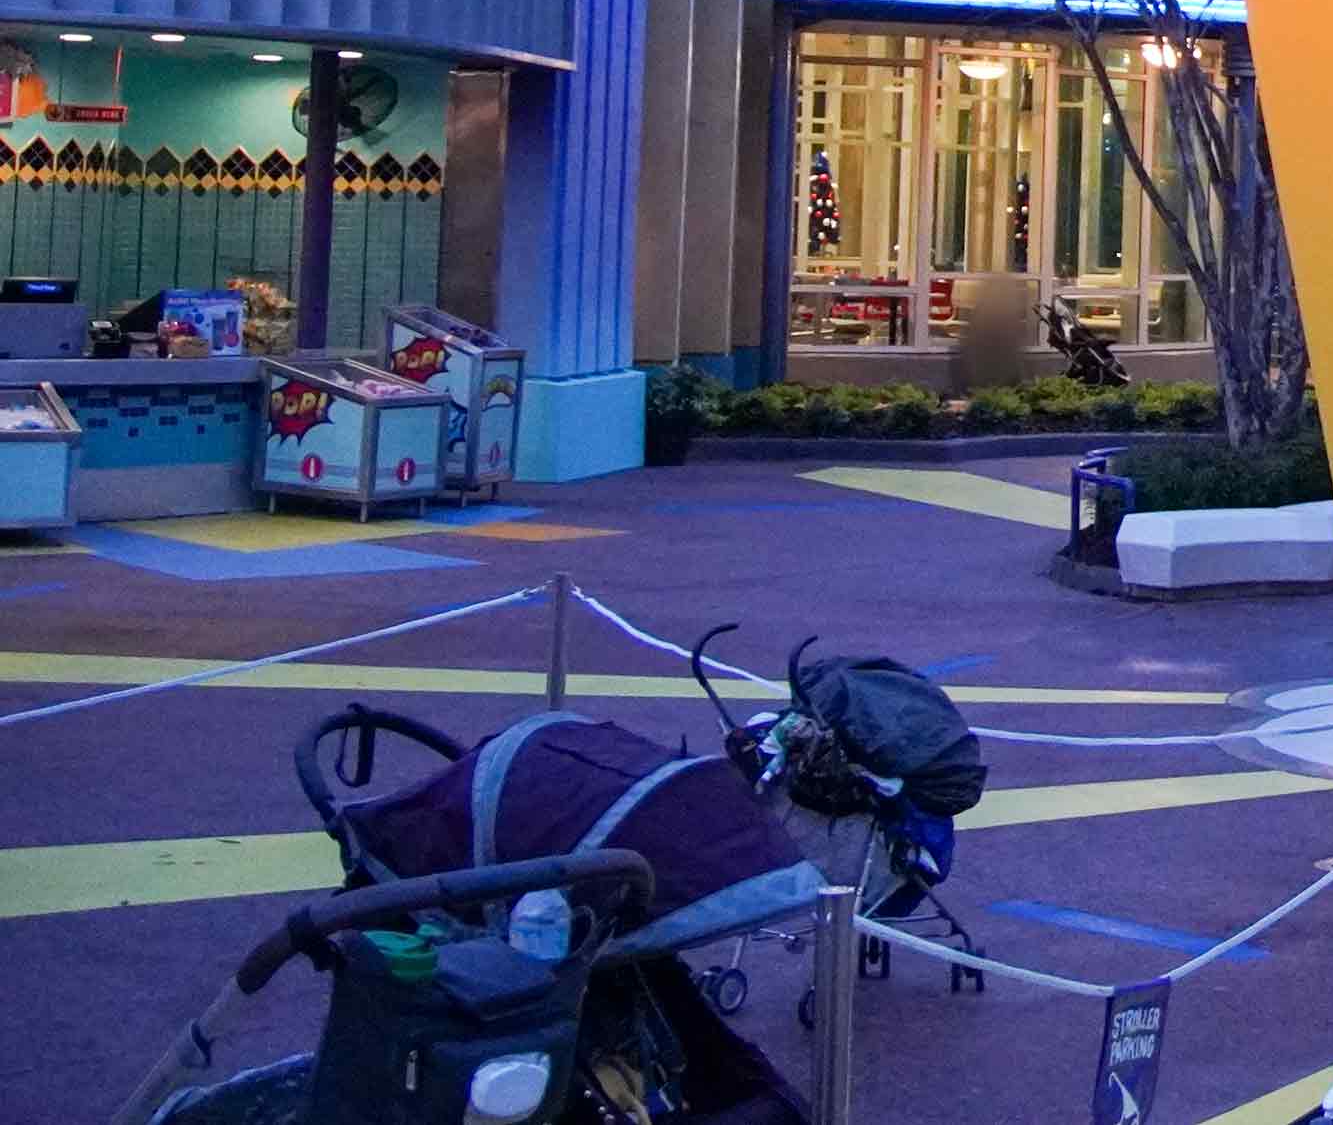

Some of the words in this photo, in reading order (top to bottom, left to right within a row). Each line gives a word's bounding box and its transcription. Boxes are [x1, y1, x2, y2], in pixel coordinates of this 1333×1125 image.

[394, 349, 446, 373] POP!
[271, 390, 329, 419] POP!
[1111, 1007, 1161, 1039] STROLLER
[1110, 1034, 1155, 1066] PARKING
